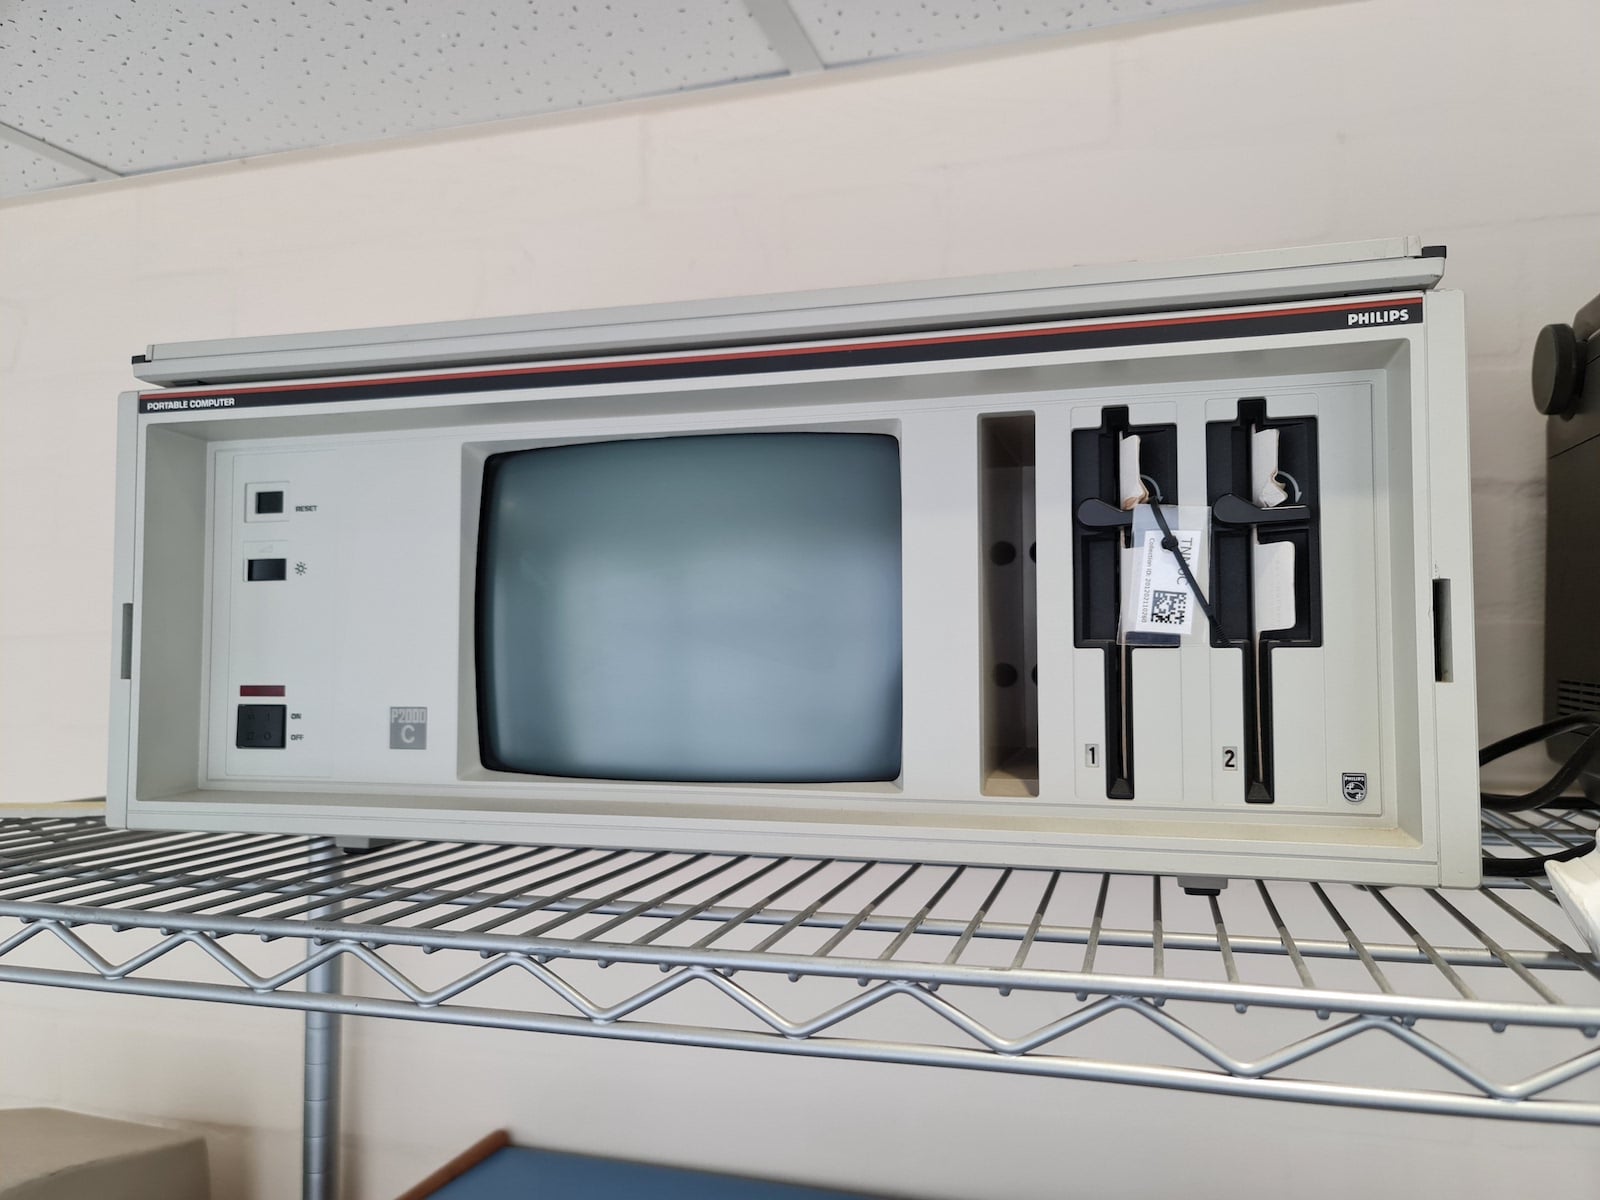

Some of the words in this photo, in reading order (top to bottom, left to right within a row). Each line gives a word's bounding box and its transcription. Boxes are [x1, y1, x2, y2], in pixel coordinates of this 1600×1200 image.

[1347, 308, 1410, 326] PHILIPS
[147, 400, 188, 411] PORTABLE
[189, 397, 235, 409] COMPUTER
[1146, 537, 1155, 567] Collection
[391, 708, 426, 723] P2000
[400, 724, 415, 744] C
[1088, 746, 1096, 765] 1
[1224, 749, 1235, 768] 2
